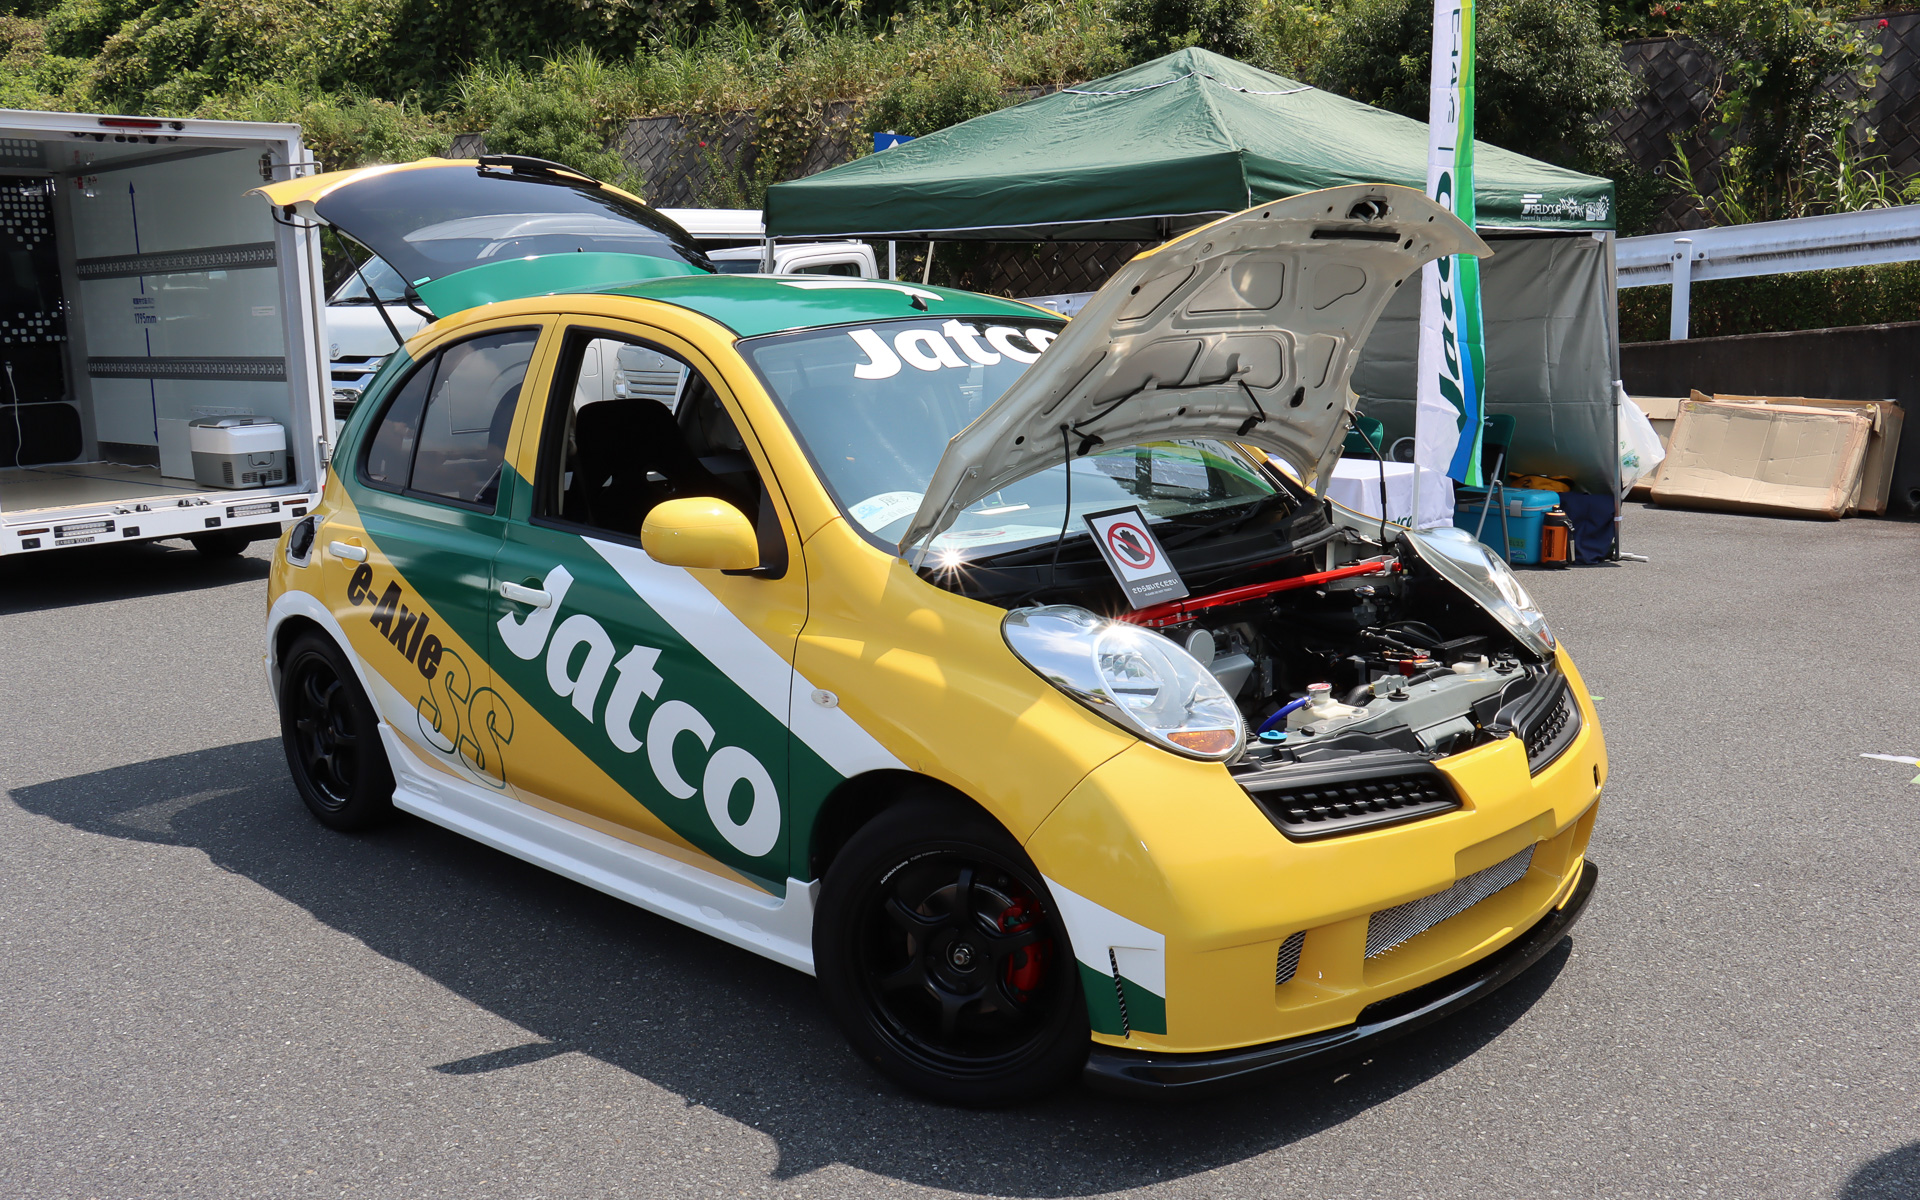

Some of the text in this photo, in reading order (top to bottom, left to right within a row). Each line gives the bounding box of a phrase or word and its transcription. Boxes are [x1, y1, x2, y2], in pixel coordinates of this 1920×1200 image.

[347, 562, 515, 790] e-Axle SS
[496, 563, 782, 857] Jatco
